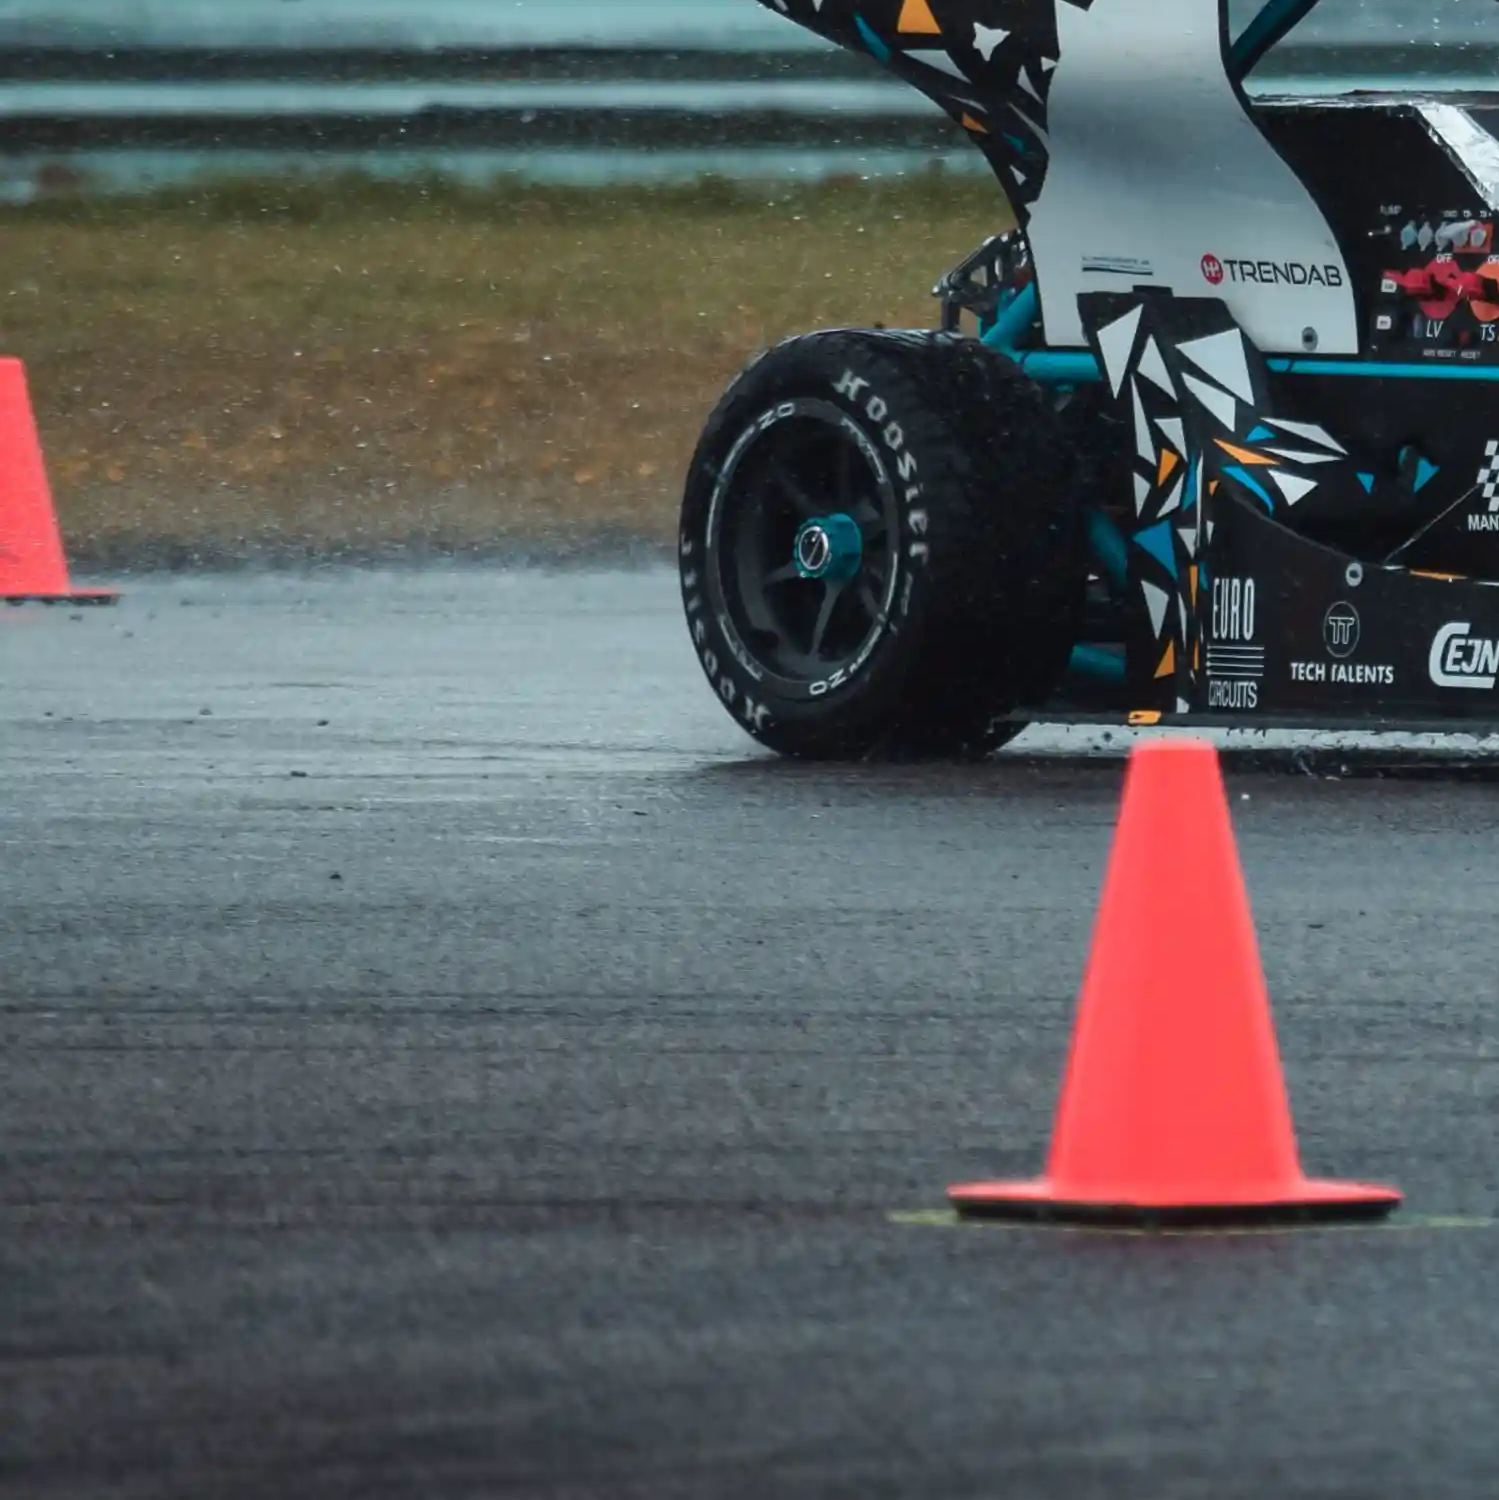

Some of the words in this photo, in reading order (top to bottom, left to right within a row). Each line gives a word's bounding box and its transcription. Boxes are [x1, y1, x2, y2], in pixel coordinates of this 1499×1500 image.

[1223, 259, 1343, 287] TRENDAB
[1425, 320, 1444, 339] LV
[1480, 323, 1497, 342] TS
[1212, 576, 1256, 642] EURO
[1290, 662, 1326, 682] TECH
[1330, 663, 1395, 685] TALENTS
[1208, 679, 1258, 709] CIRCUITS
